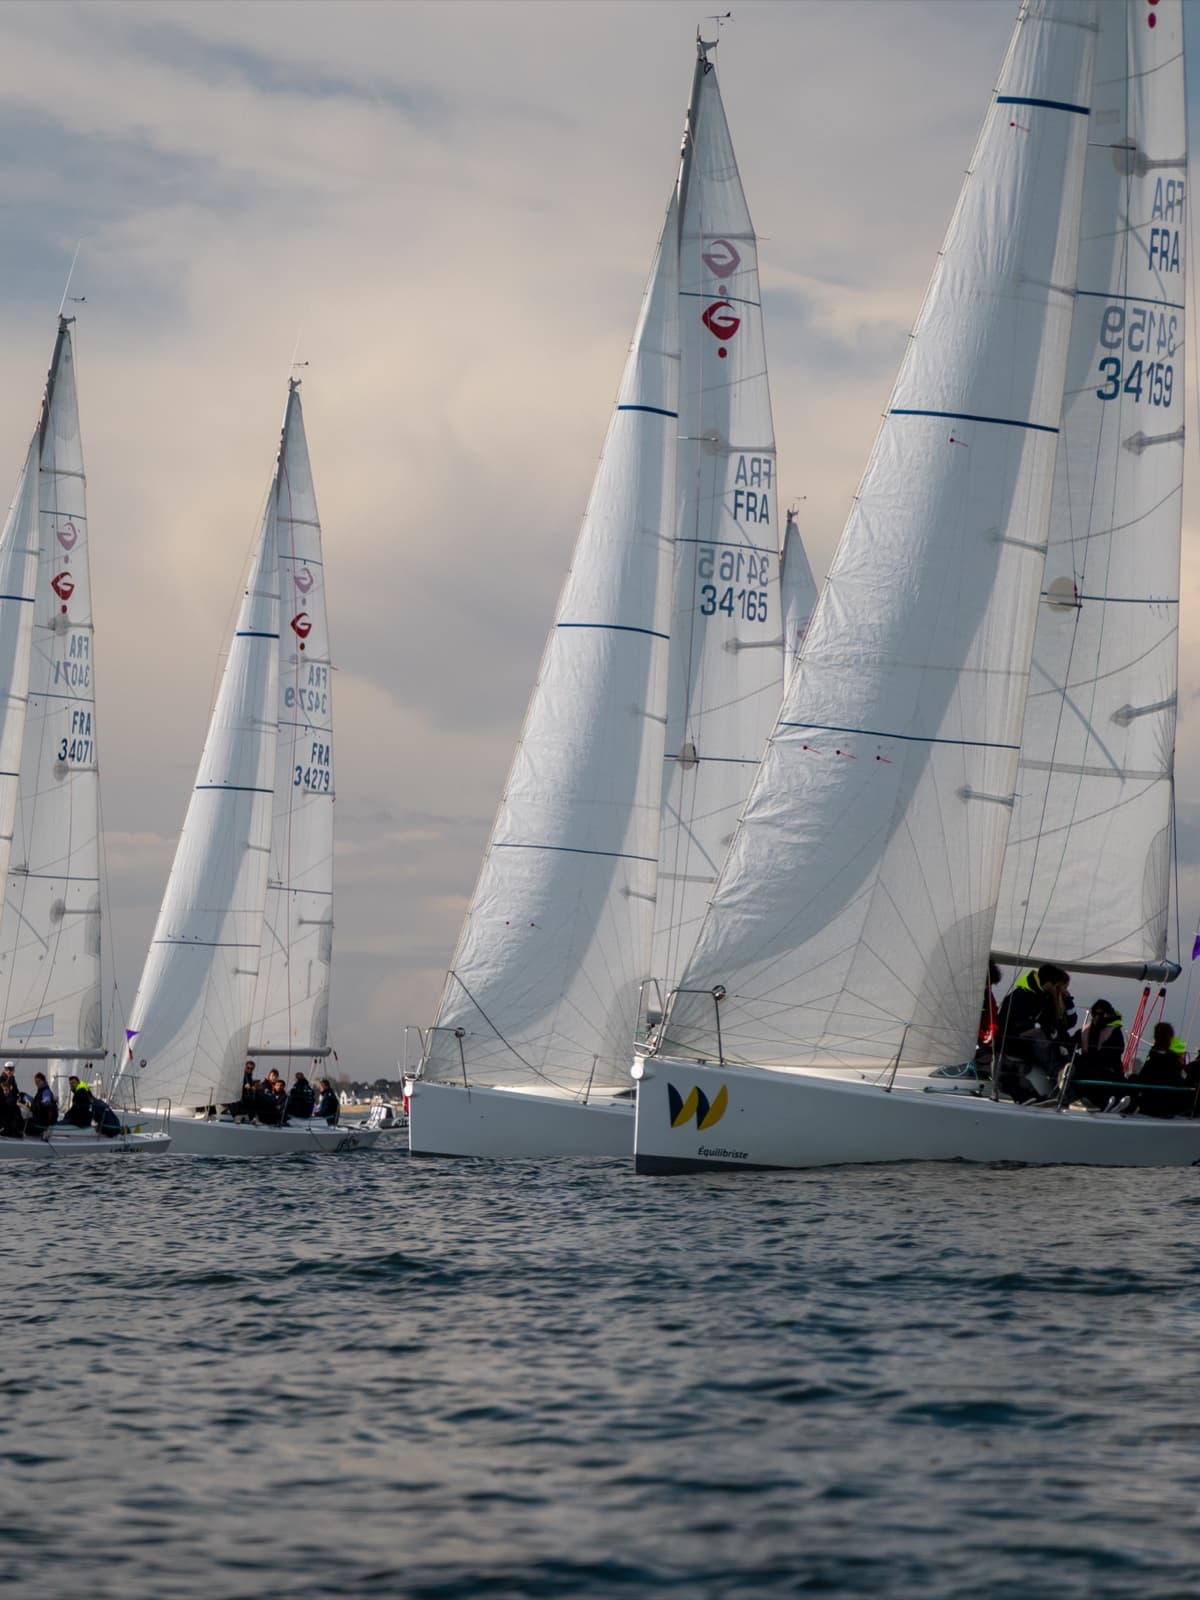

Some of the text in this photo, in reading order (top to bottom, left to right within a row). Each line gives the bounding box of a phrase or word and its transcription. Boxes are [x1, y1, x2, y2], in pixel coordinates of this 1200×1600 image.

[1149, 228, 1180, 273] FRA
[1096, 356, 1174, 408] 34159
[733, 490, 769, 525] FRA
[700, 584, 769, 622] 34165
[72, 711, 92, 737] FRA
[58, 738, 93, 764] 34071
[311, 742, 330, 766] FRA
[294, 766, 330, 792] 34279
